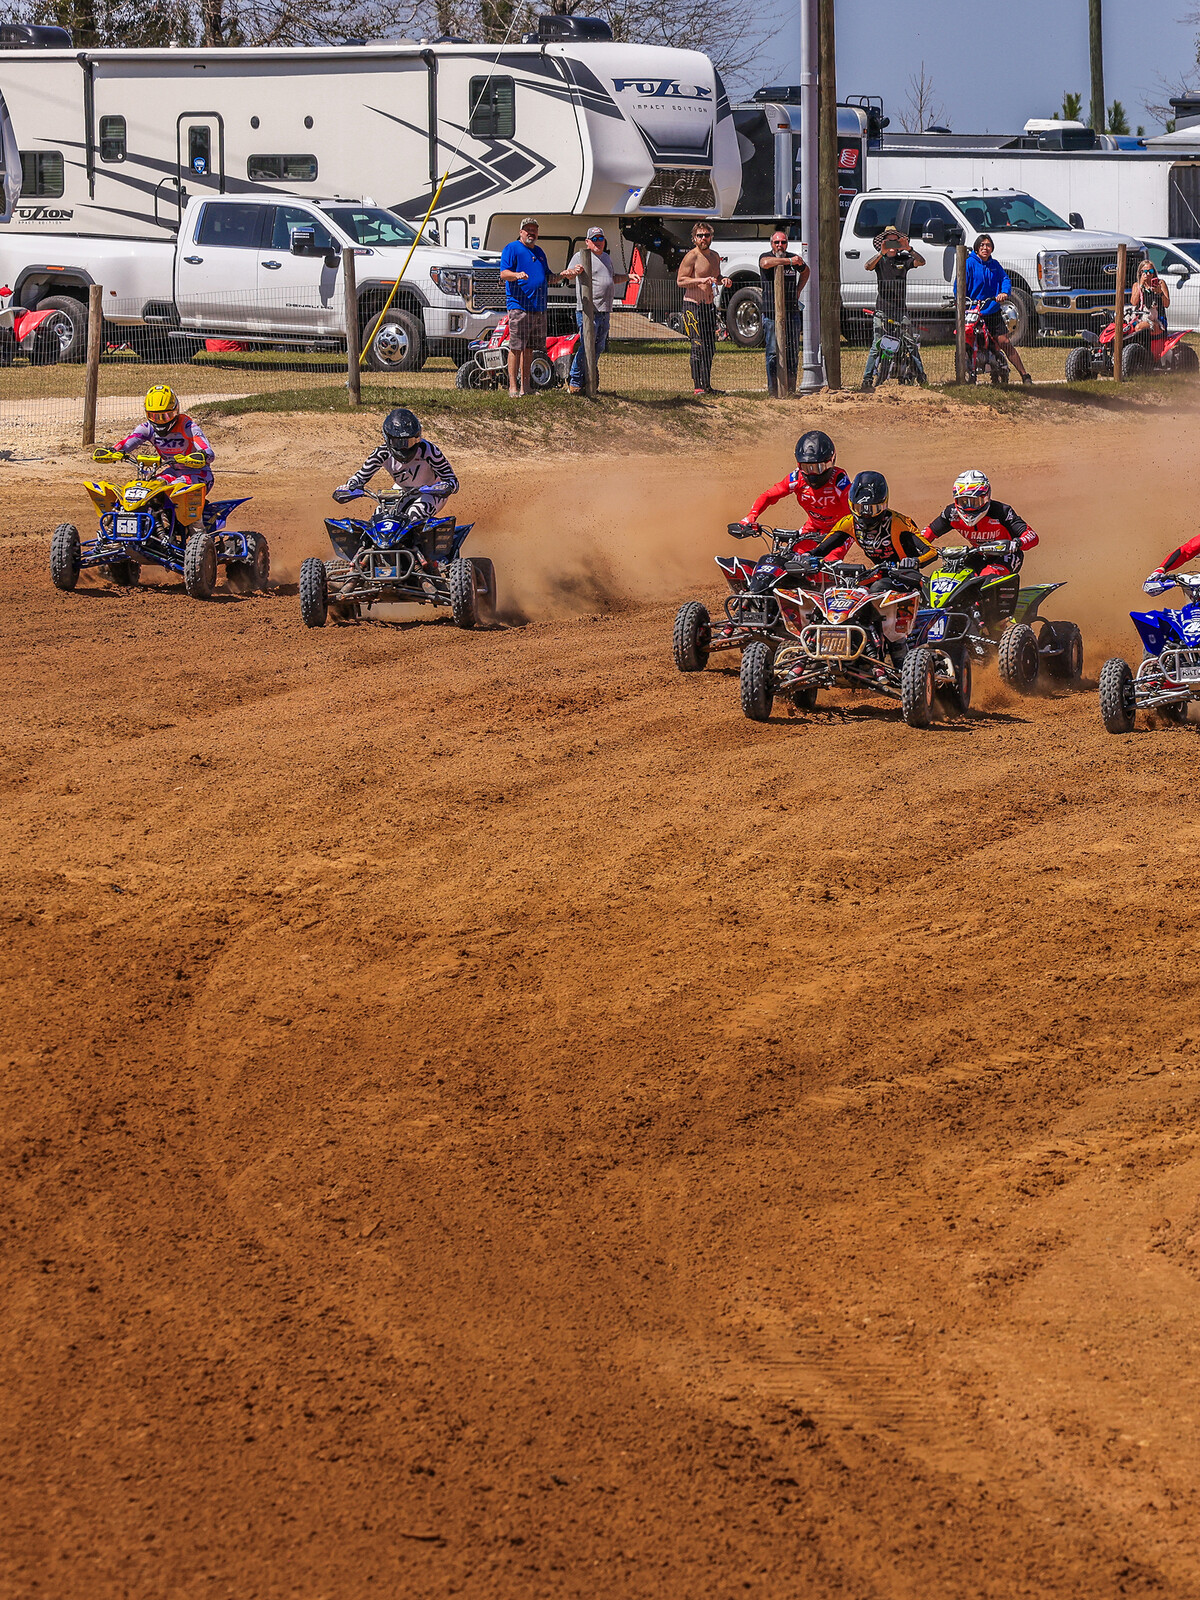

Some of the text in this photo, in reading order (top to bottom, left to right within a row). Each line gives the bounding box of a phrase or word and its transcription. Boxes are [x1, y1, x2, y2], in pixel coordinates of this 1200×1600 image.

[612, 78, 712, 101] FUZION
[13, 206, 74, 221] UZION
[154, 438, 186, 448] FXR
[801, 493, 836, 506] FXR
[117, 519, 138, 534] 68
[380, 521, 394, 532] 3
[971, 529, 1001, 540] RACING
[831, 600, 852, 609] 900
[821, 637, 848, 652] 900
